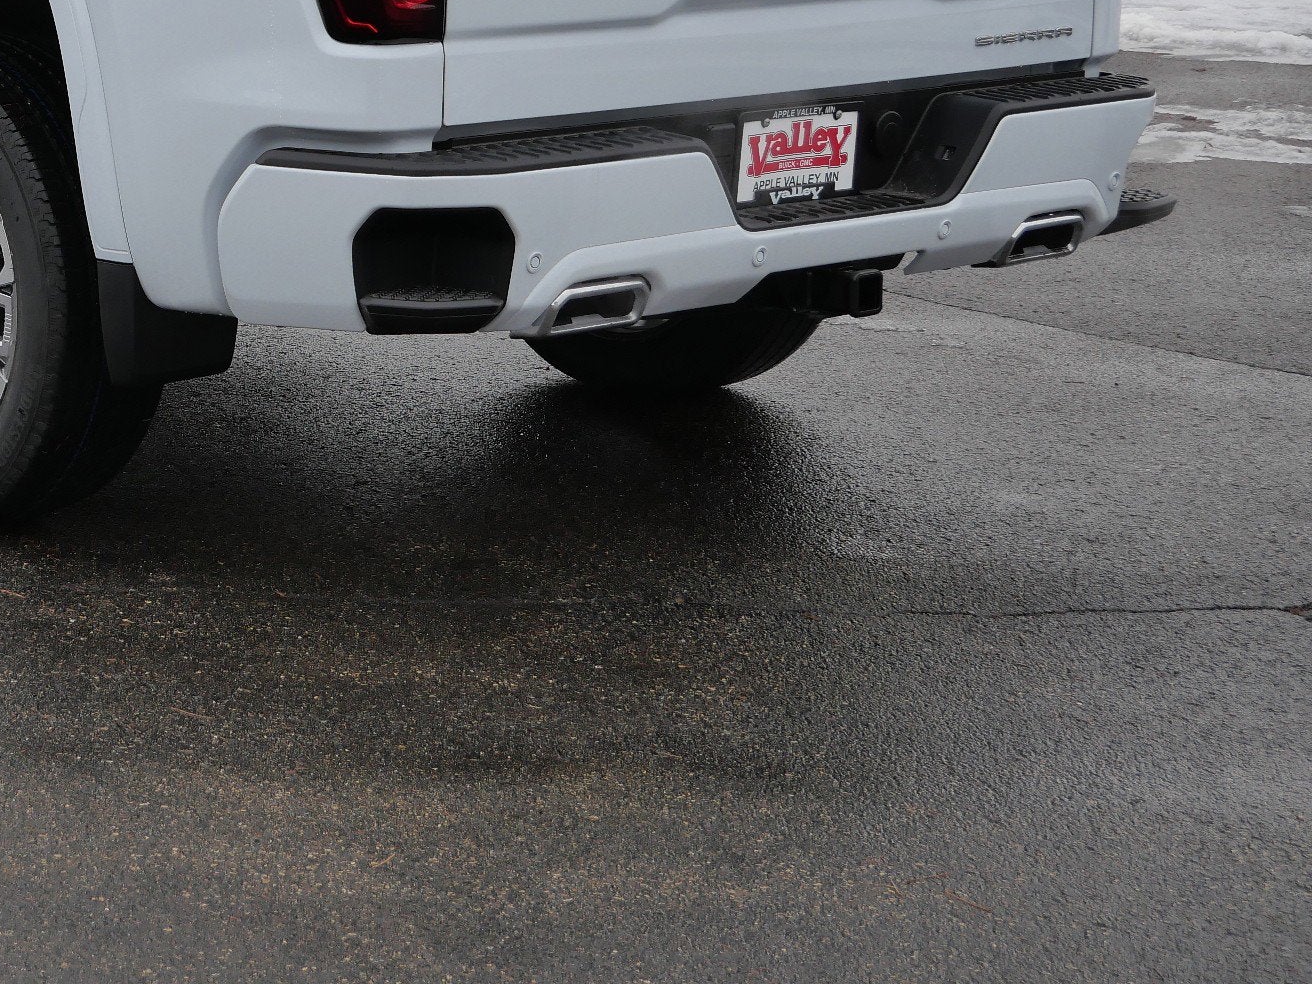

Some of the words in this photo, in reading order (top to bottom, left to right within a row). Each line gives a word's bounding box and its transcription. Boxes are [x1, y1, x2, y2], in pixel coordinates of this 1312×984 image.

[974, 26, 1073, 47] SIERRA
[773, 109, 794, 119] APPLE
[825, 105, 836, 114] MN
[747, 119, 852, 178] Valley
[778, 161, 795, 170] BUICK
[799, 158, 813, 167] GMC
[753, 177, 782, 192] APPLE
[825, 171, 840, 182] MN
